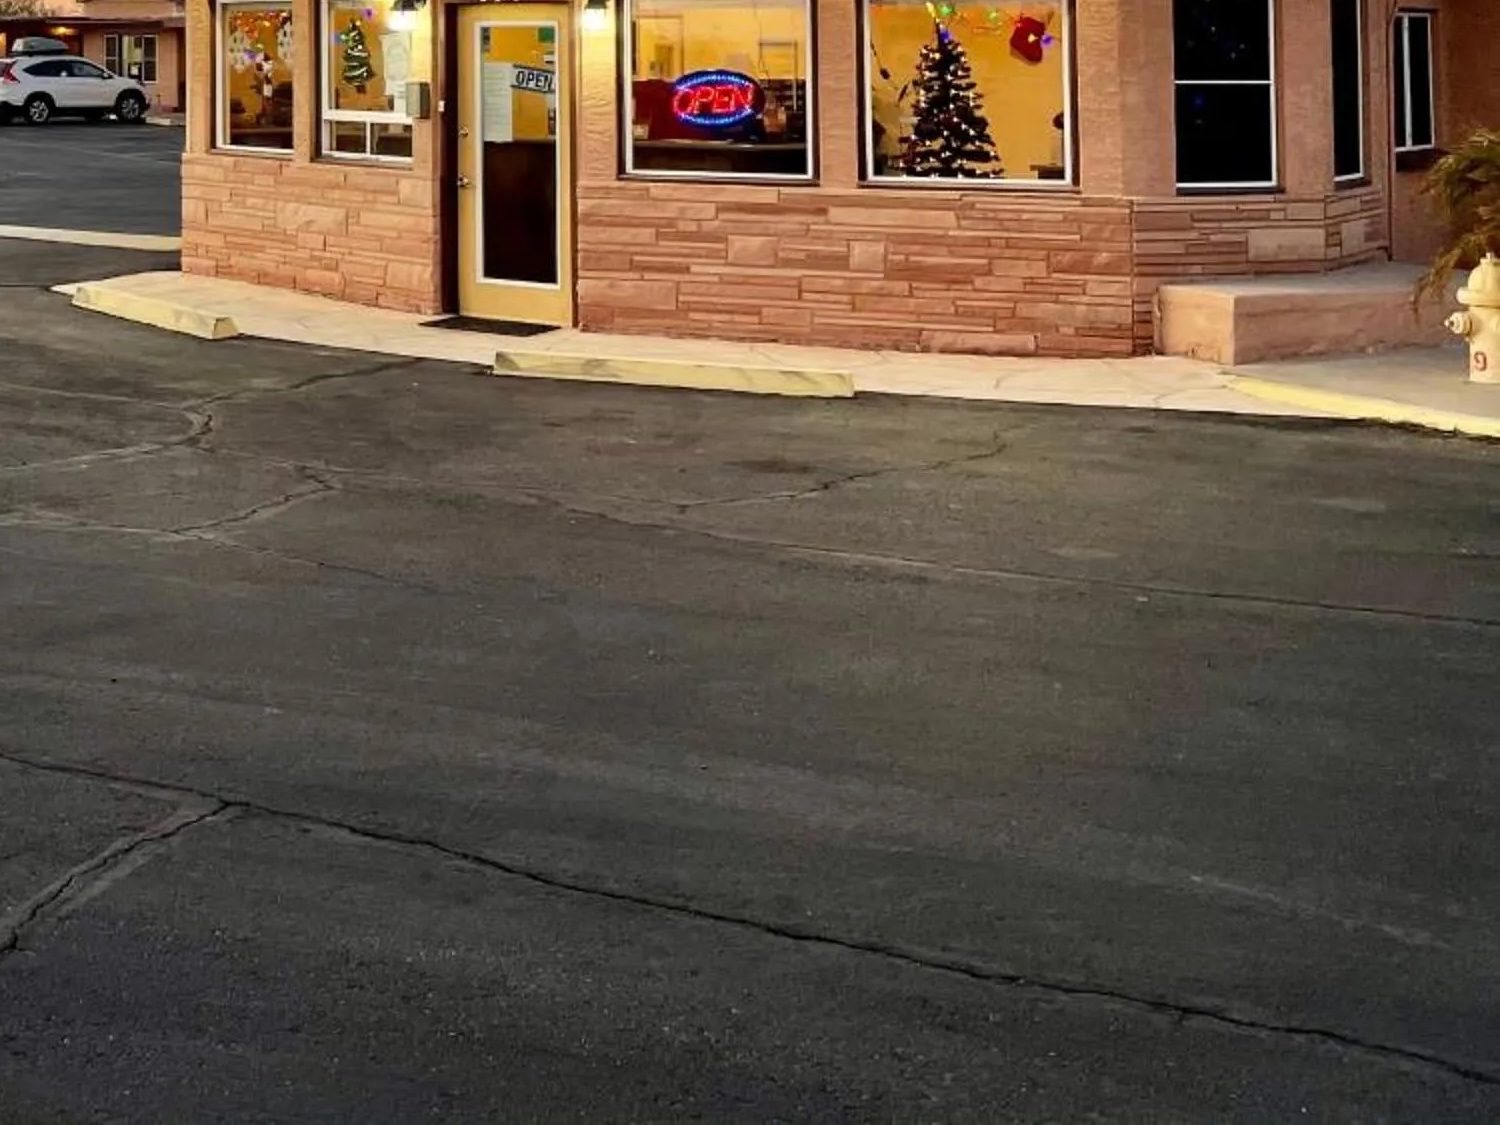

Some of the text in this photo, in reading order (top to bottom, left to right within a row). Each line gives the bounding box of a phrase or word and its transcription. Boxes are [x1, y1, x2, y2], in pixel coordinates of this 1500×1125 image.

[515, 70, 553, 91] OPEN
[673, 83, 755, 115] OPEN
[1474, 351, 1488, 372] 9
